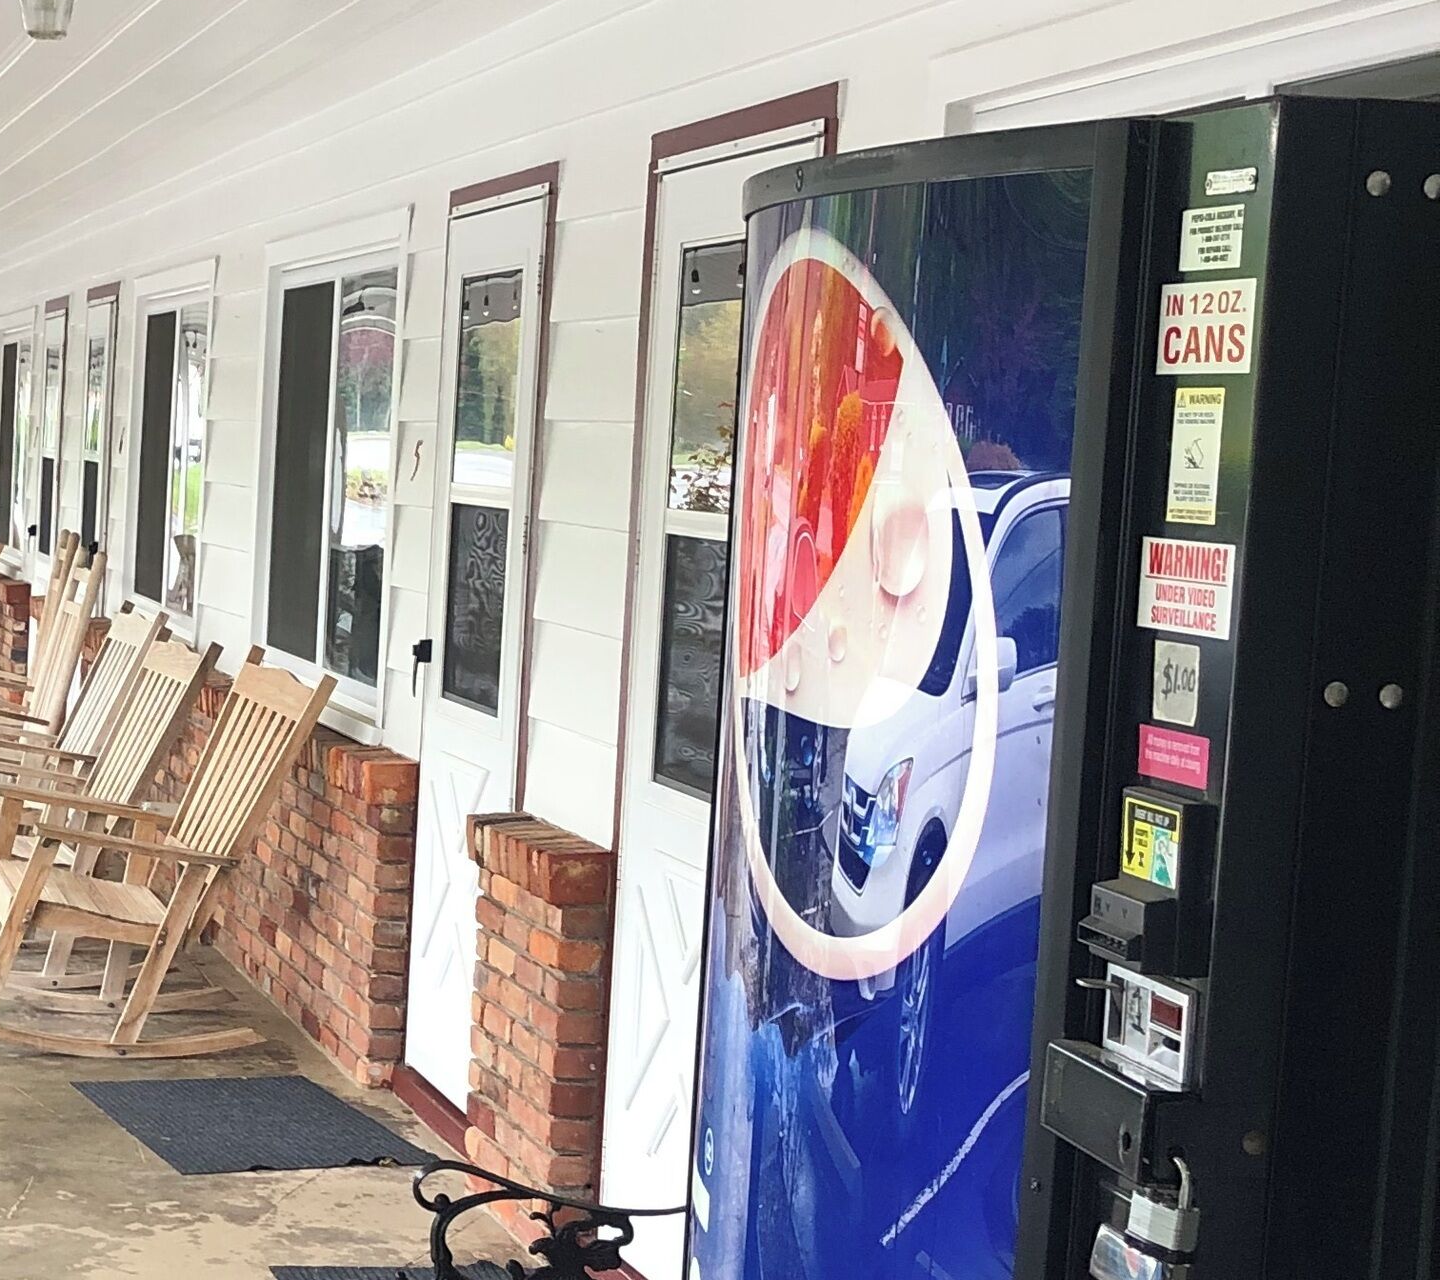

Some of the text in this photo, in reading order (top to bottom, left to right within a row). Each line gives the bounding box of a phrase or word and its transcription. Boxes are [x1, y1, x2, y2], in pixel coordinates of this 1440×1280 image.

[1165, 290, 1247, 317] IN 12 OZ.
[1163, 323, 1246, 365] CANS
[1188, 393, 1222, 405] WARNING
[1149, 541, 1229, 582] WARNING!
[1155, 583, 1216, 609] UNDER VIDEO
[1151, 605, 1217, 632] SURVEILLANCE
[1161, 657, 1196, 700] $1.00
